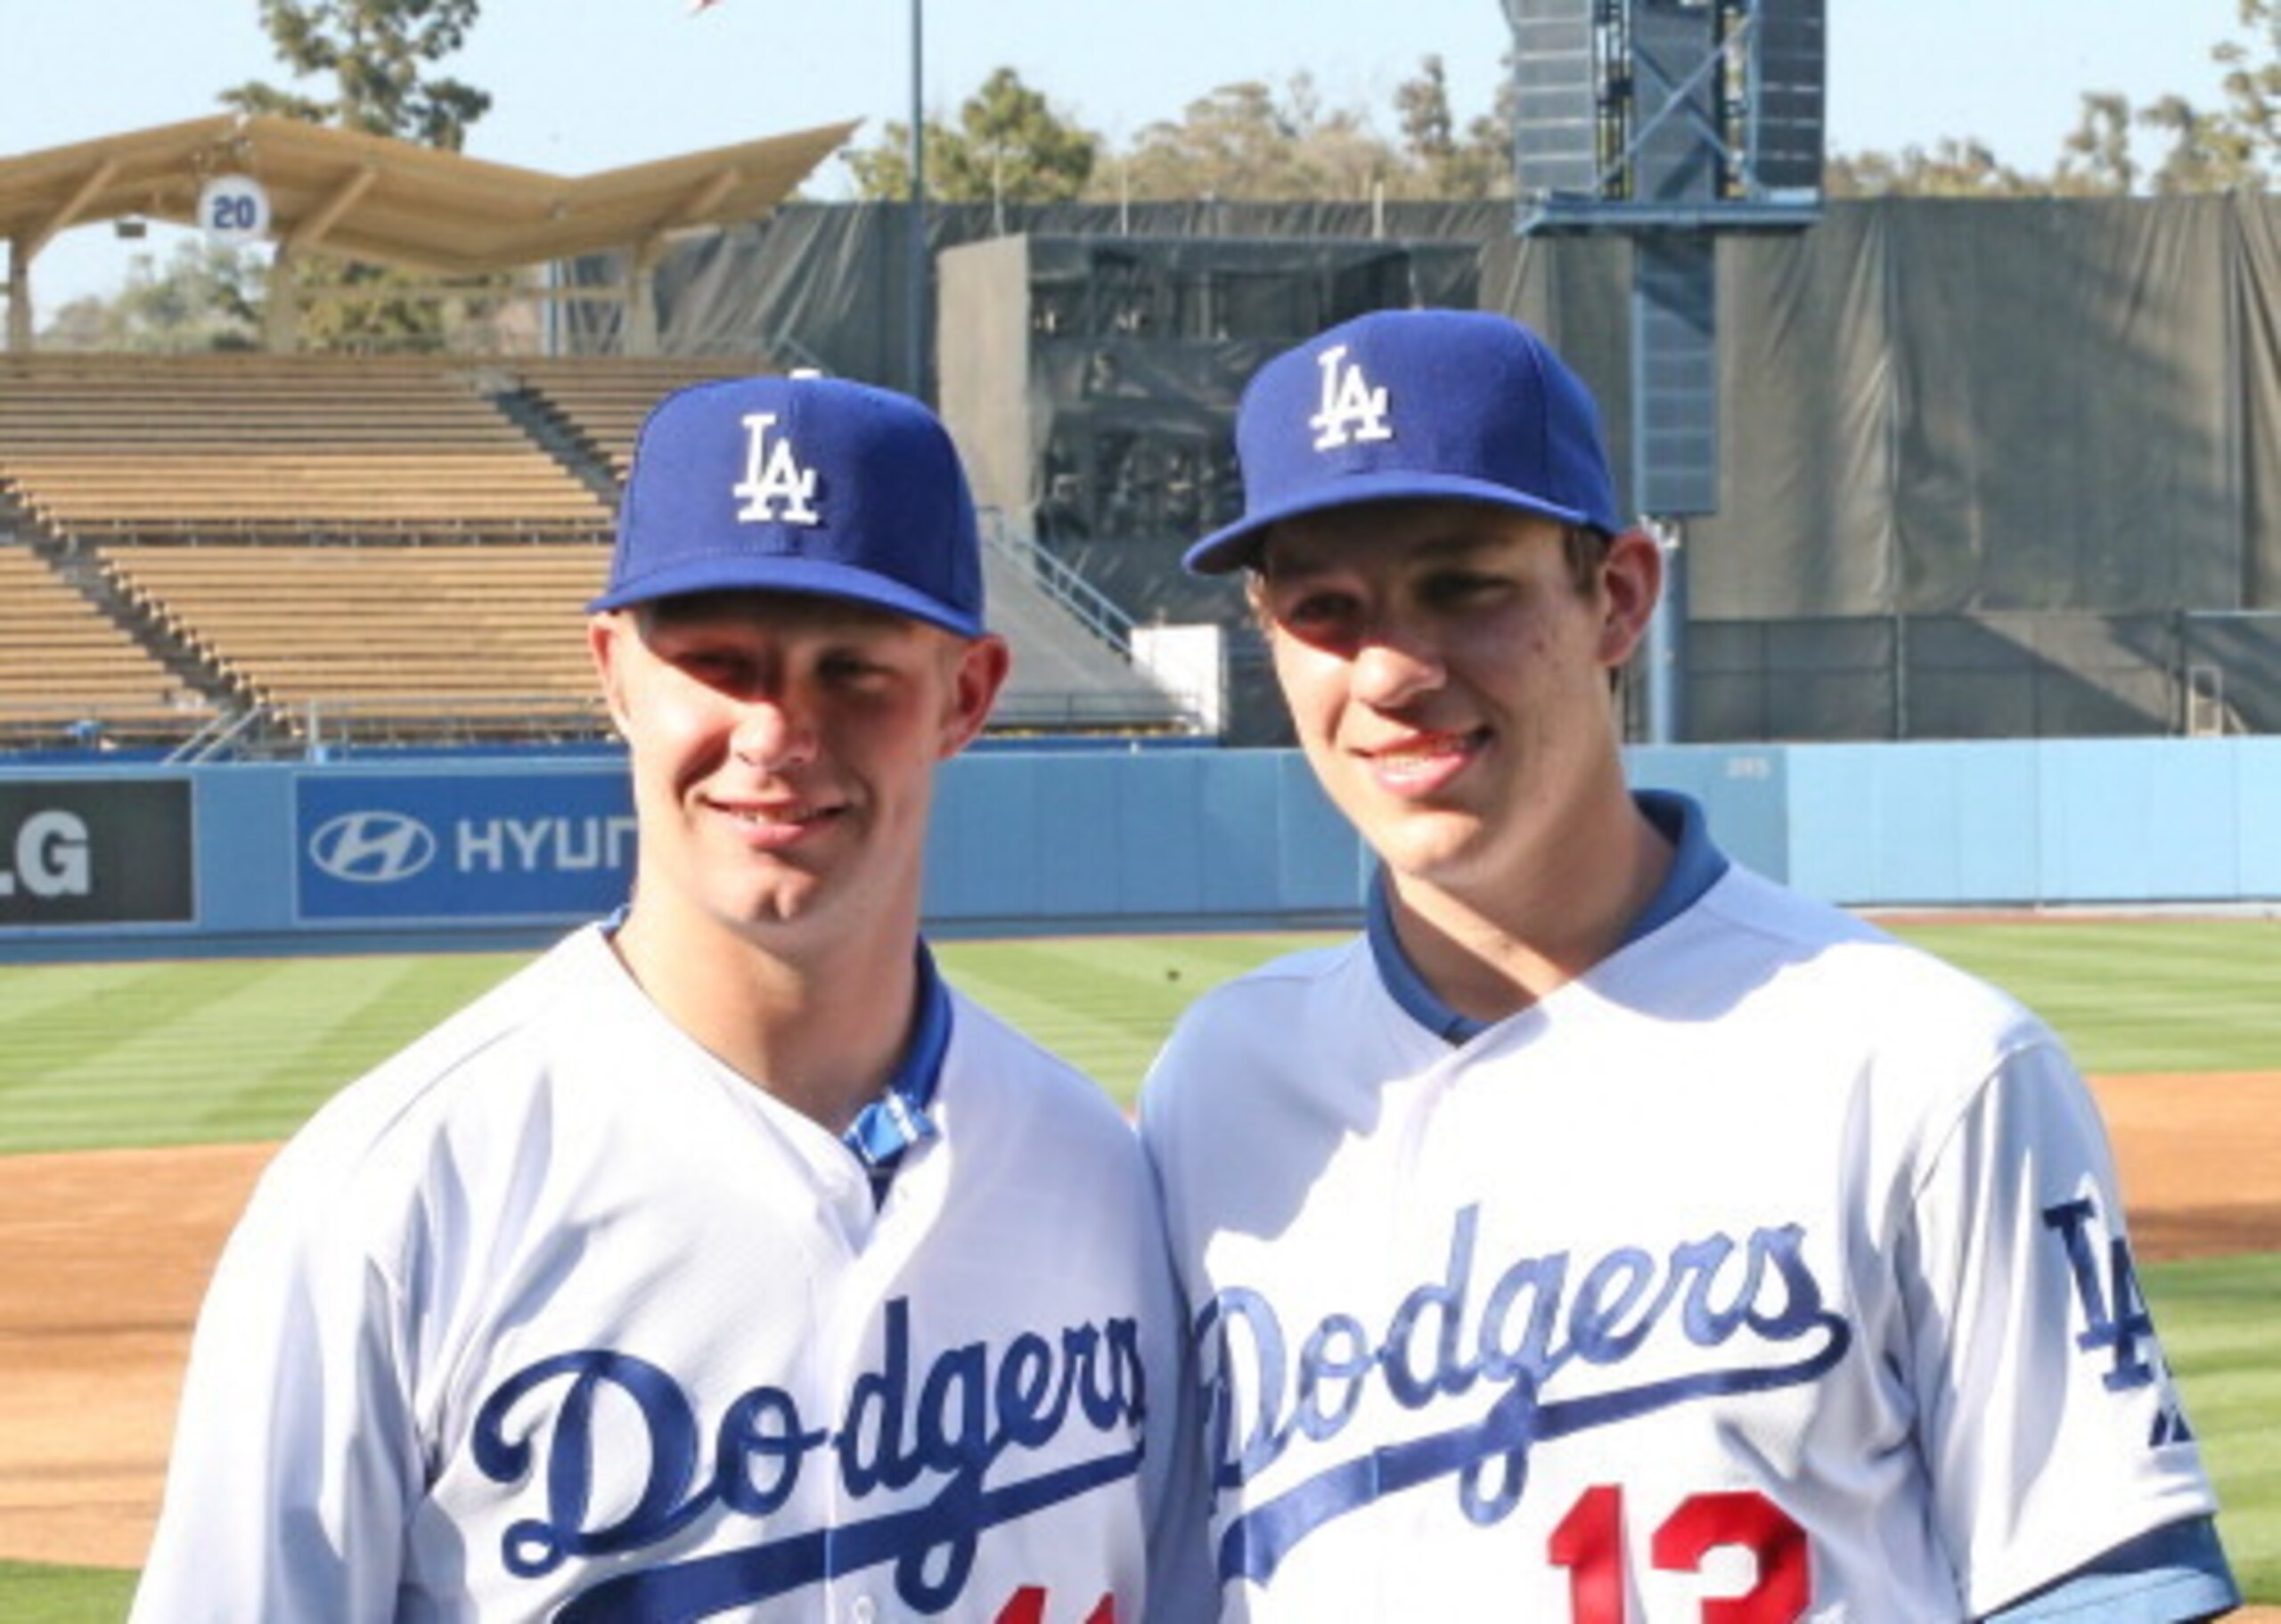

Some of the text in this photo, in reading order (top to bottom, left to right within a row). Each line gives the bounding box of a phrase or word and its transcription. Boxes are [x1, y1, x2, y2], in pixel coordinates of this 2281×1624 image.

[213, 195, 257, 230] 20
[1311, 345, 1393, 451] LA
[733, 413, 818, 525] LA
[0, 809, 89, 898] G
[1195, 1203, 1850, 1525] Dodgers
